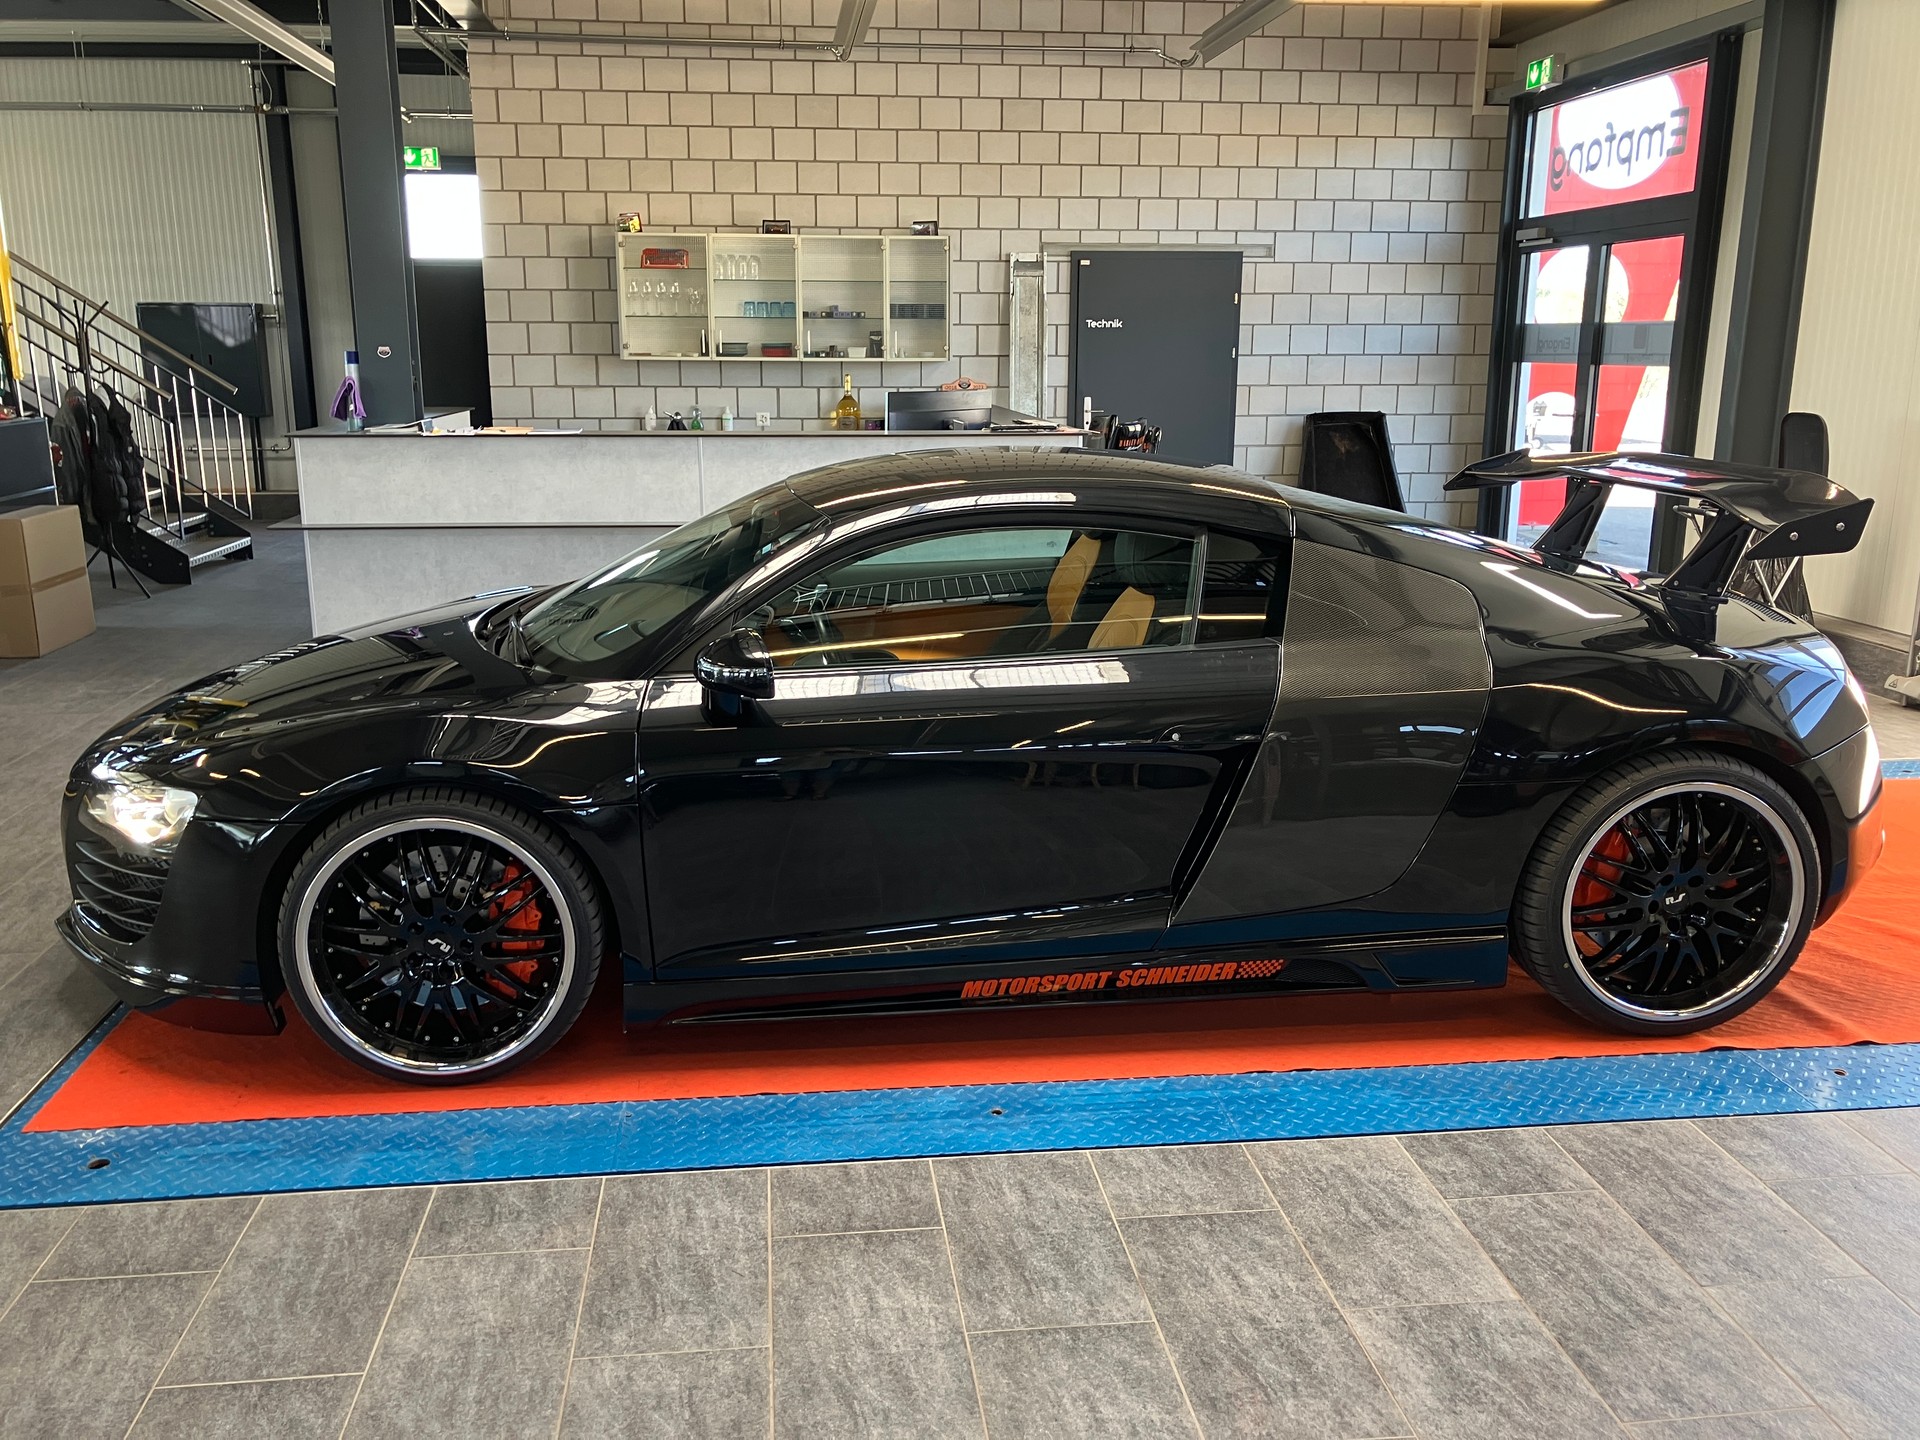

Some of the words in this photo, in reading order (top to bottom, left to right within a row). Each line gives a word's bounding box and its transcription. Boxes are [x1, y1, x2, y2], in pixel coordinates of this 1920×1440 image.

[1085, 318, 1123, 328] Technik
[1665, 892, 1686, 905] RS
[960, 971, 1113, 999] MOTORSPORT
[1115, 961, 1238, 988] SCHNEIDER
